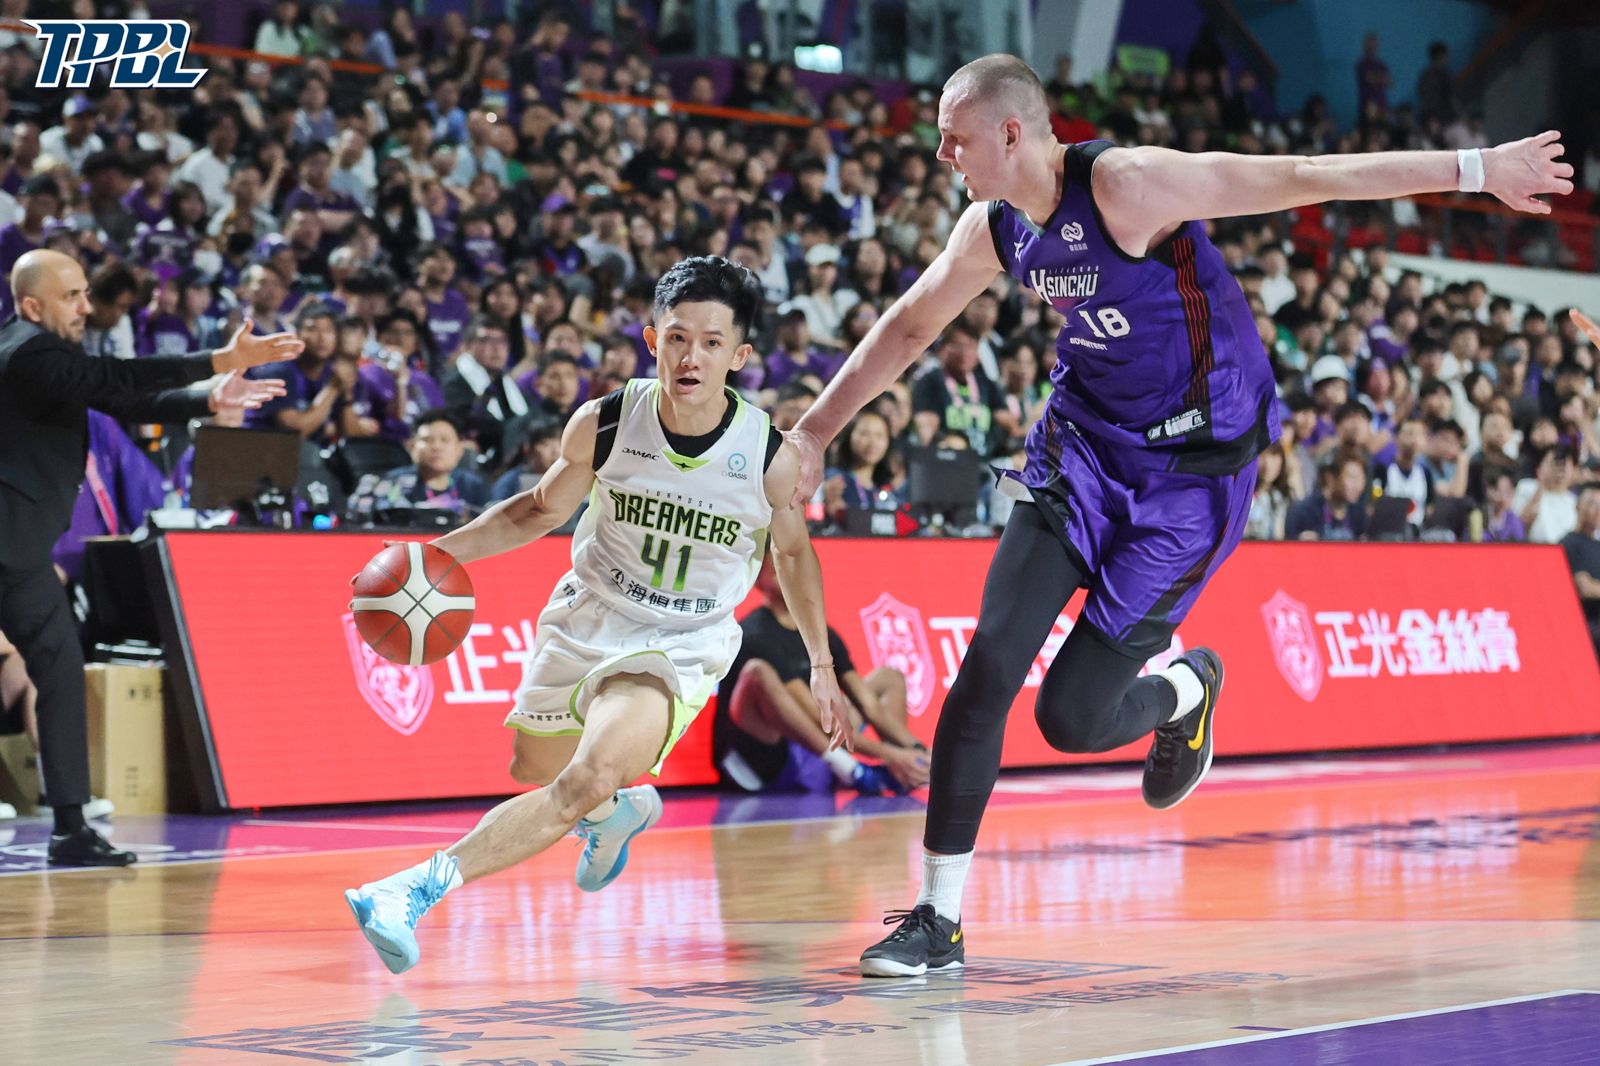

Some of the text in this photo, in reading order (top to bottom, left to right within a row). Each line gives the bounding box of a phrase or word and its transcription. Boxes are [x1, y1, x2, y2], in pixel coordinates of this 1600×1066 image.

[1029, 269, 1099, 306] HSINCHU
[1078, 307, 1131, 339] 18
[608, 487, 742, 548] DREAMERS
[640, 532, 694, 592] 41
